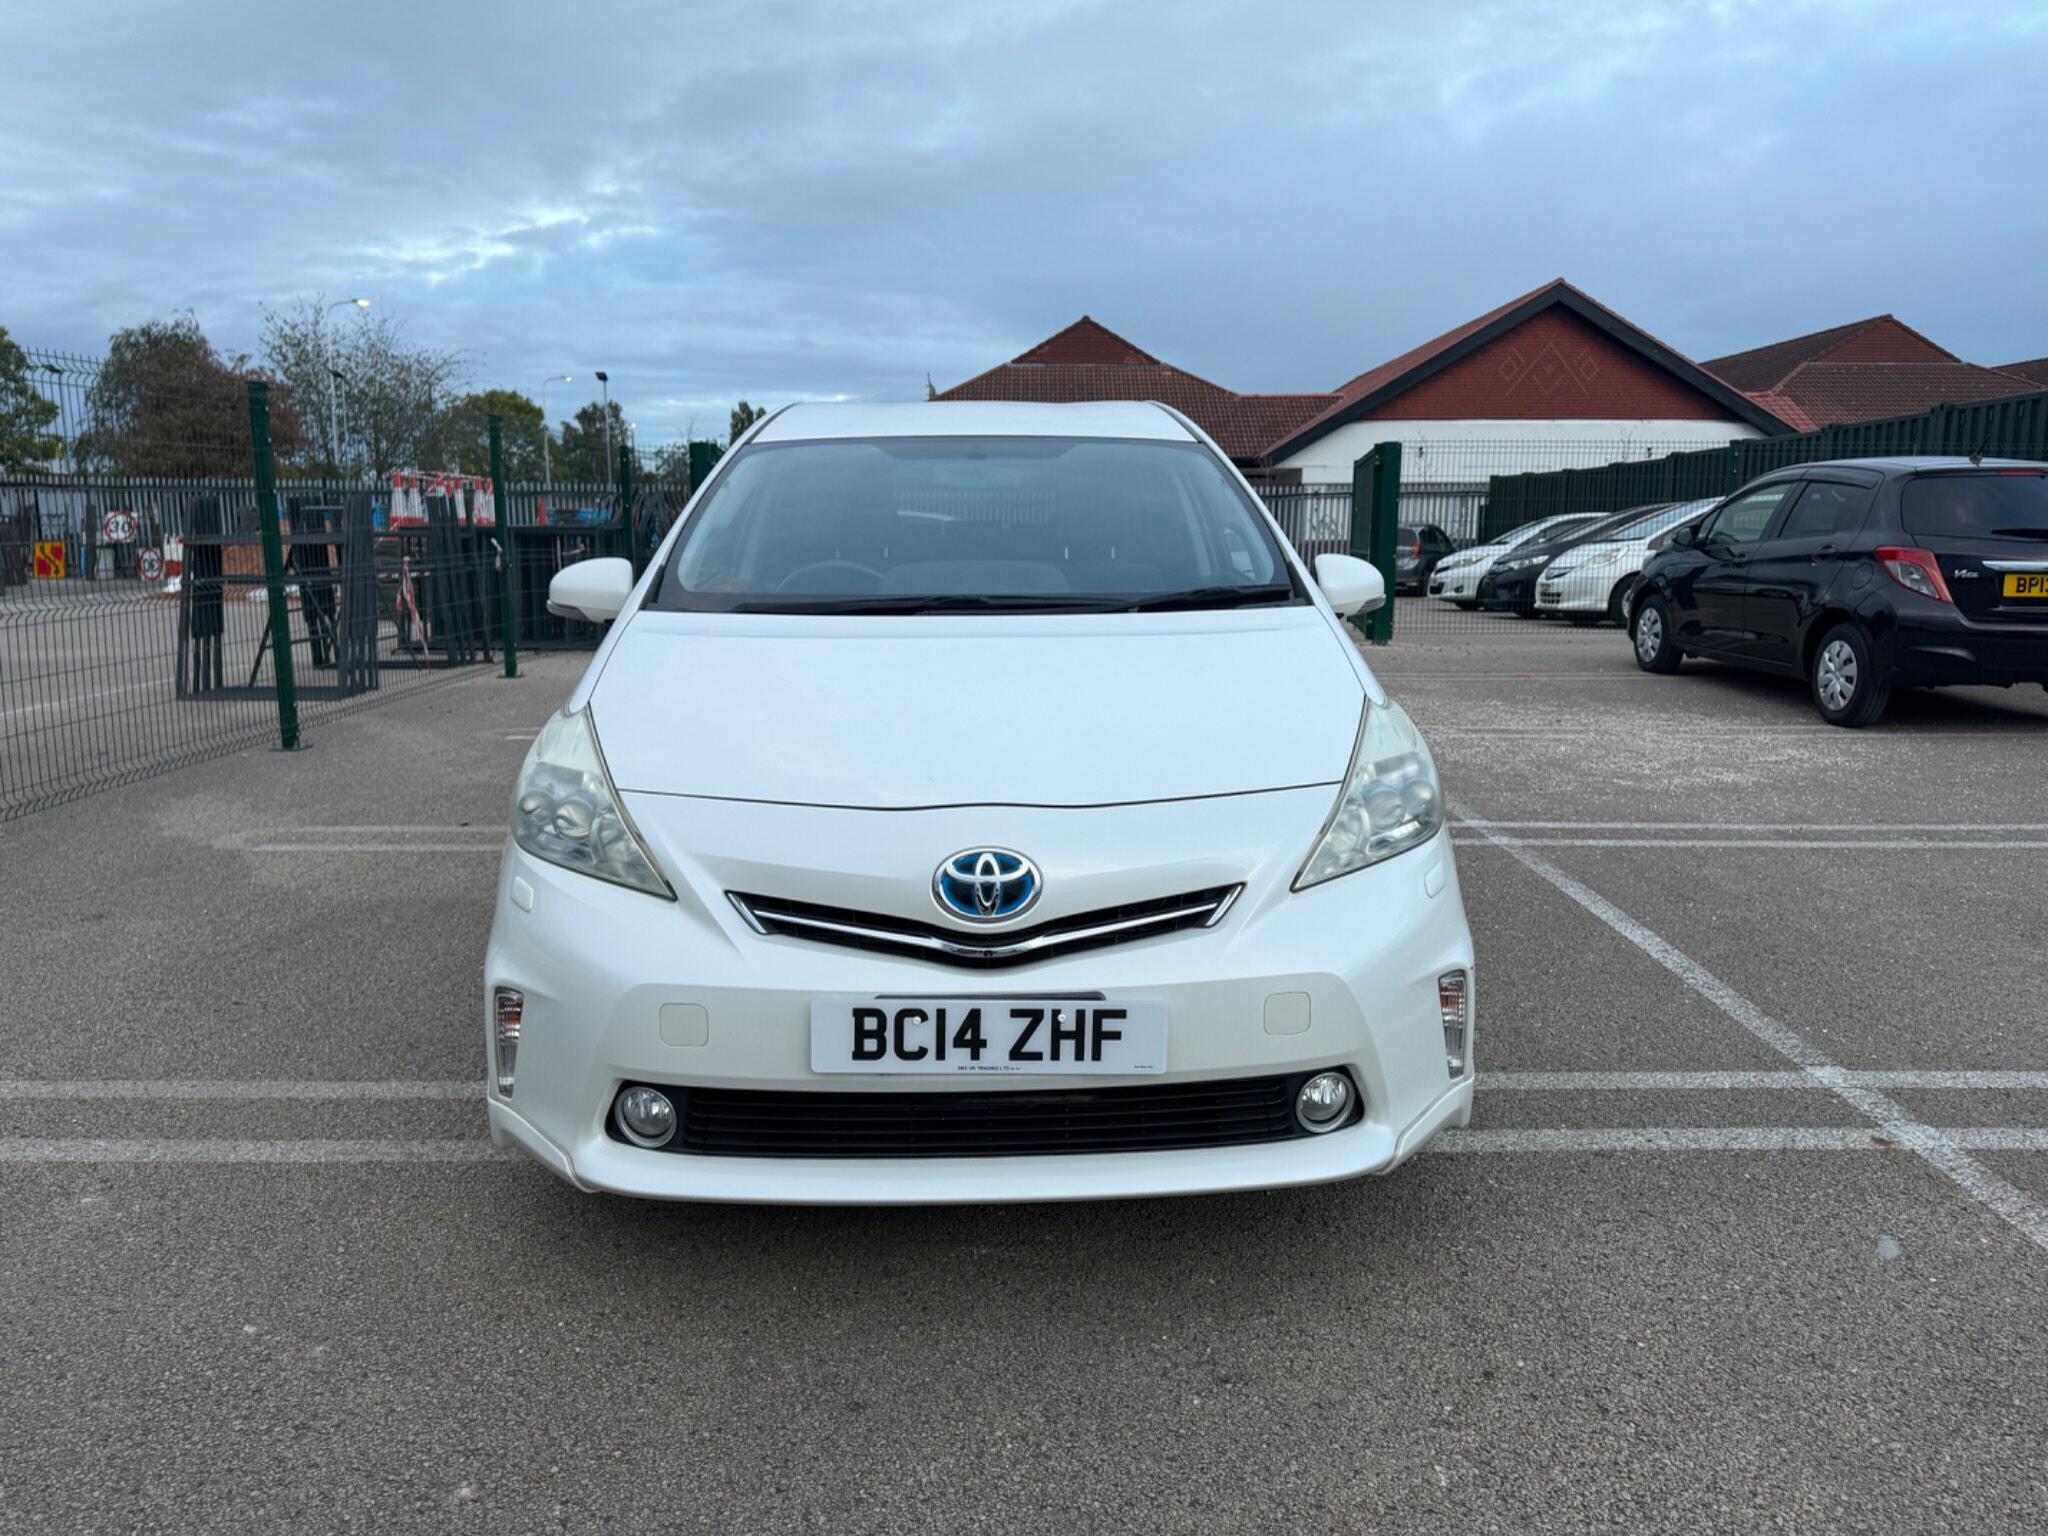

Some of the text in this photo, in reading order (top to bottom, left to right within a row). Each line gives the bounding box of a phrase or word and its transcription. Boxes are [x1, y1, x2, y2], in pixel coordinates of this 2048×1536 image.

[109, 521, 132, 533] 30
[2016, 577, 2048, 593] BP1
[852, 1008, 1127, 1061] BC14 ZHF
